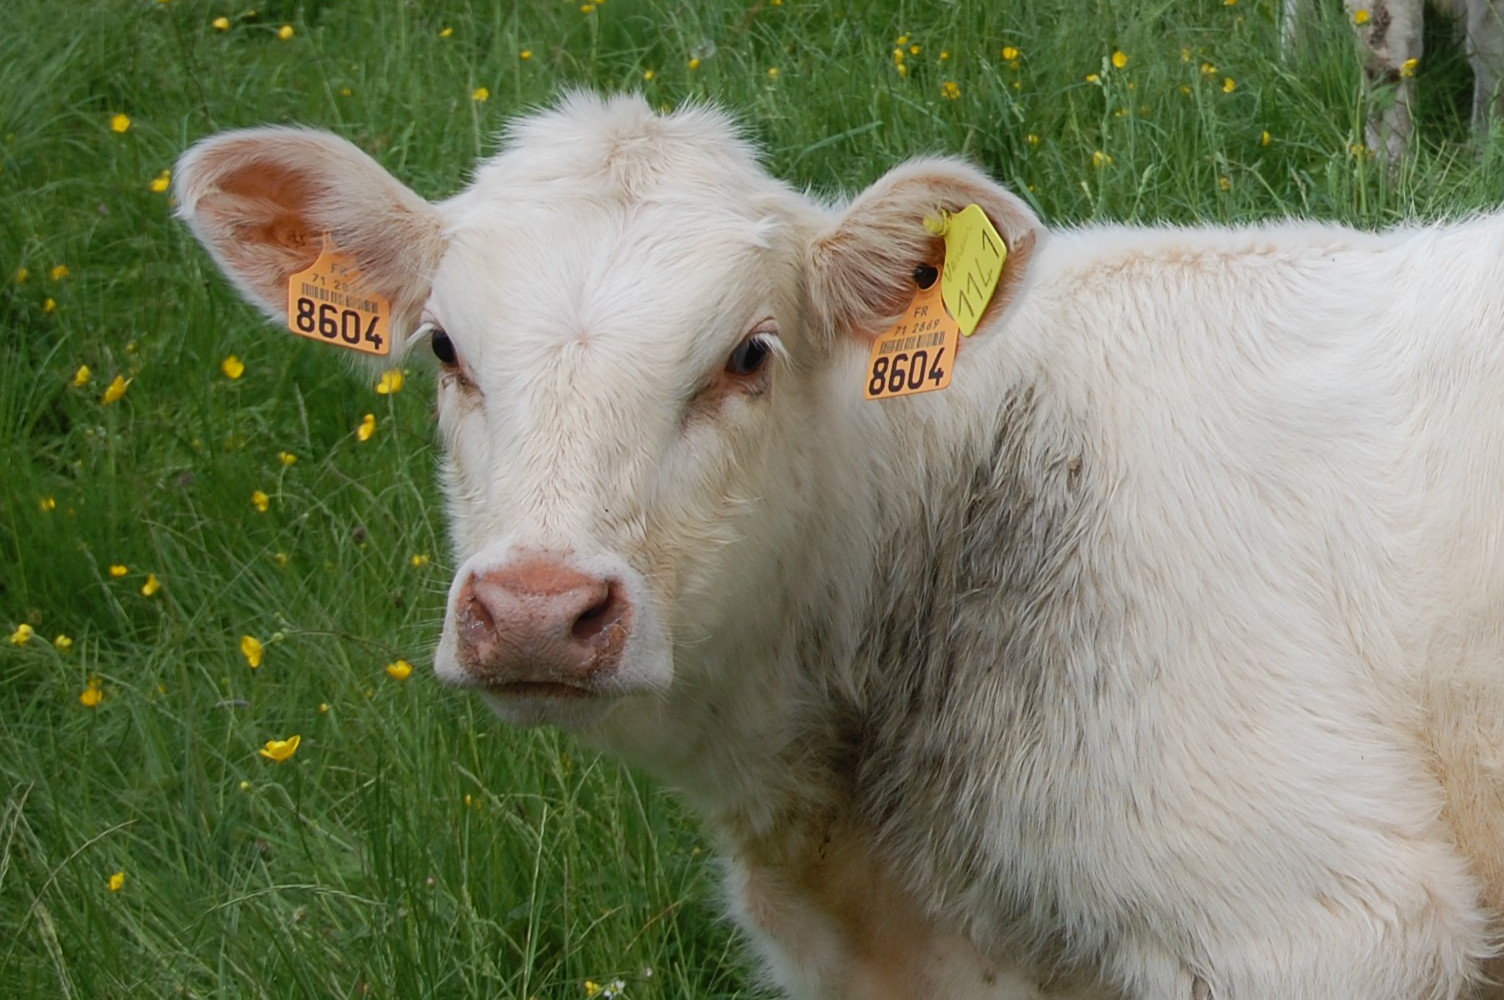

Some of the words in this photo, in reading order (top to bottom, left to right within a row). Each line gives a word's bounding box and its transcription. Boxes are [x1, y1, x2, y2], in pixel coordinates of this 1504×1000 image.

[312, 272, 325, 286] 71
[913, 305, 929, 318] FR
[296, 297, 383, 350] 8604
[894, 324, 907, 336] 71
[911, 318, 940, 334] 2869
[868, 347, 945, 396] 8604
